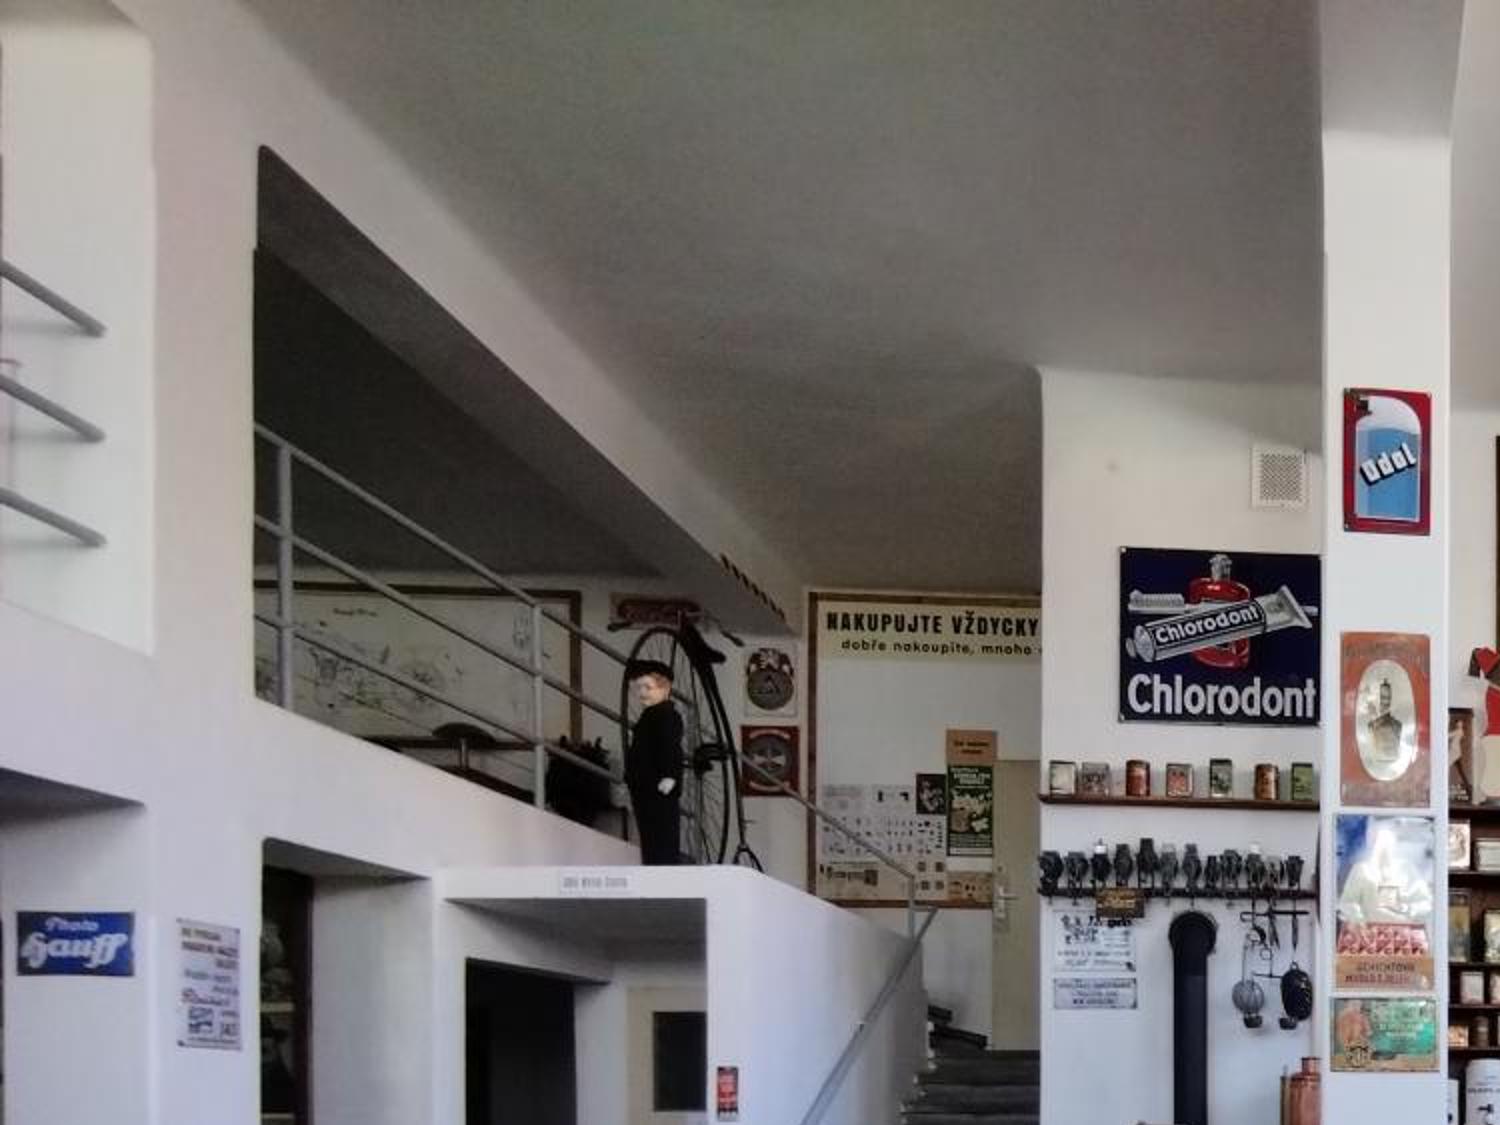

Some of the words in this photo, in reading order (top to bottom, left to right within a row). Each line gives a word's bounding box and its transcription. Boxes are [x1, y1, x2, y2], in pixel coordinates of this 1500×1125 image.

[826, 611, 943, 634] NAKUPUJTE
[951, 610, 1039, 636] VŽDYCKY
[1154, 602, 1261, 645] Chlorodont
[841, 639, 886, 651] dobře
[981, 644, 1032, 655] mnoho
[1128, 672, 1317, 719] Chlorodont
